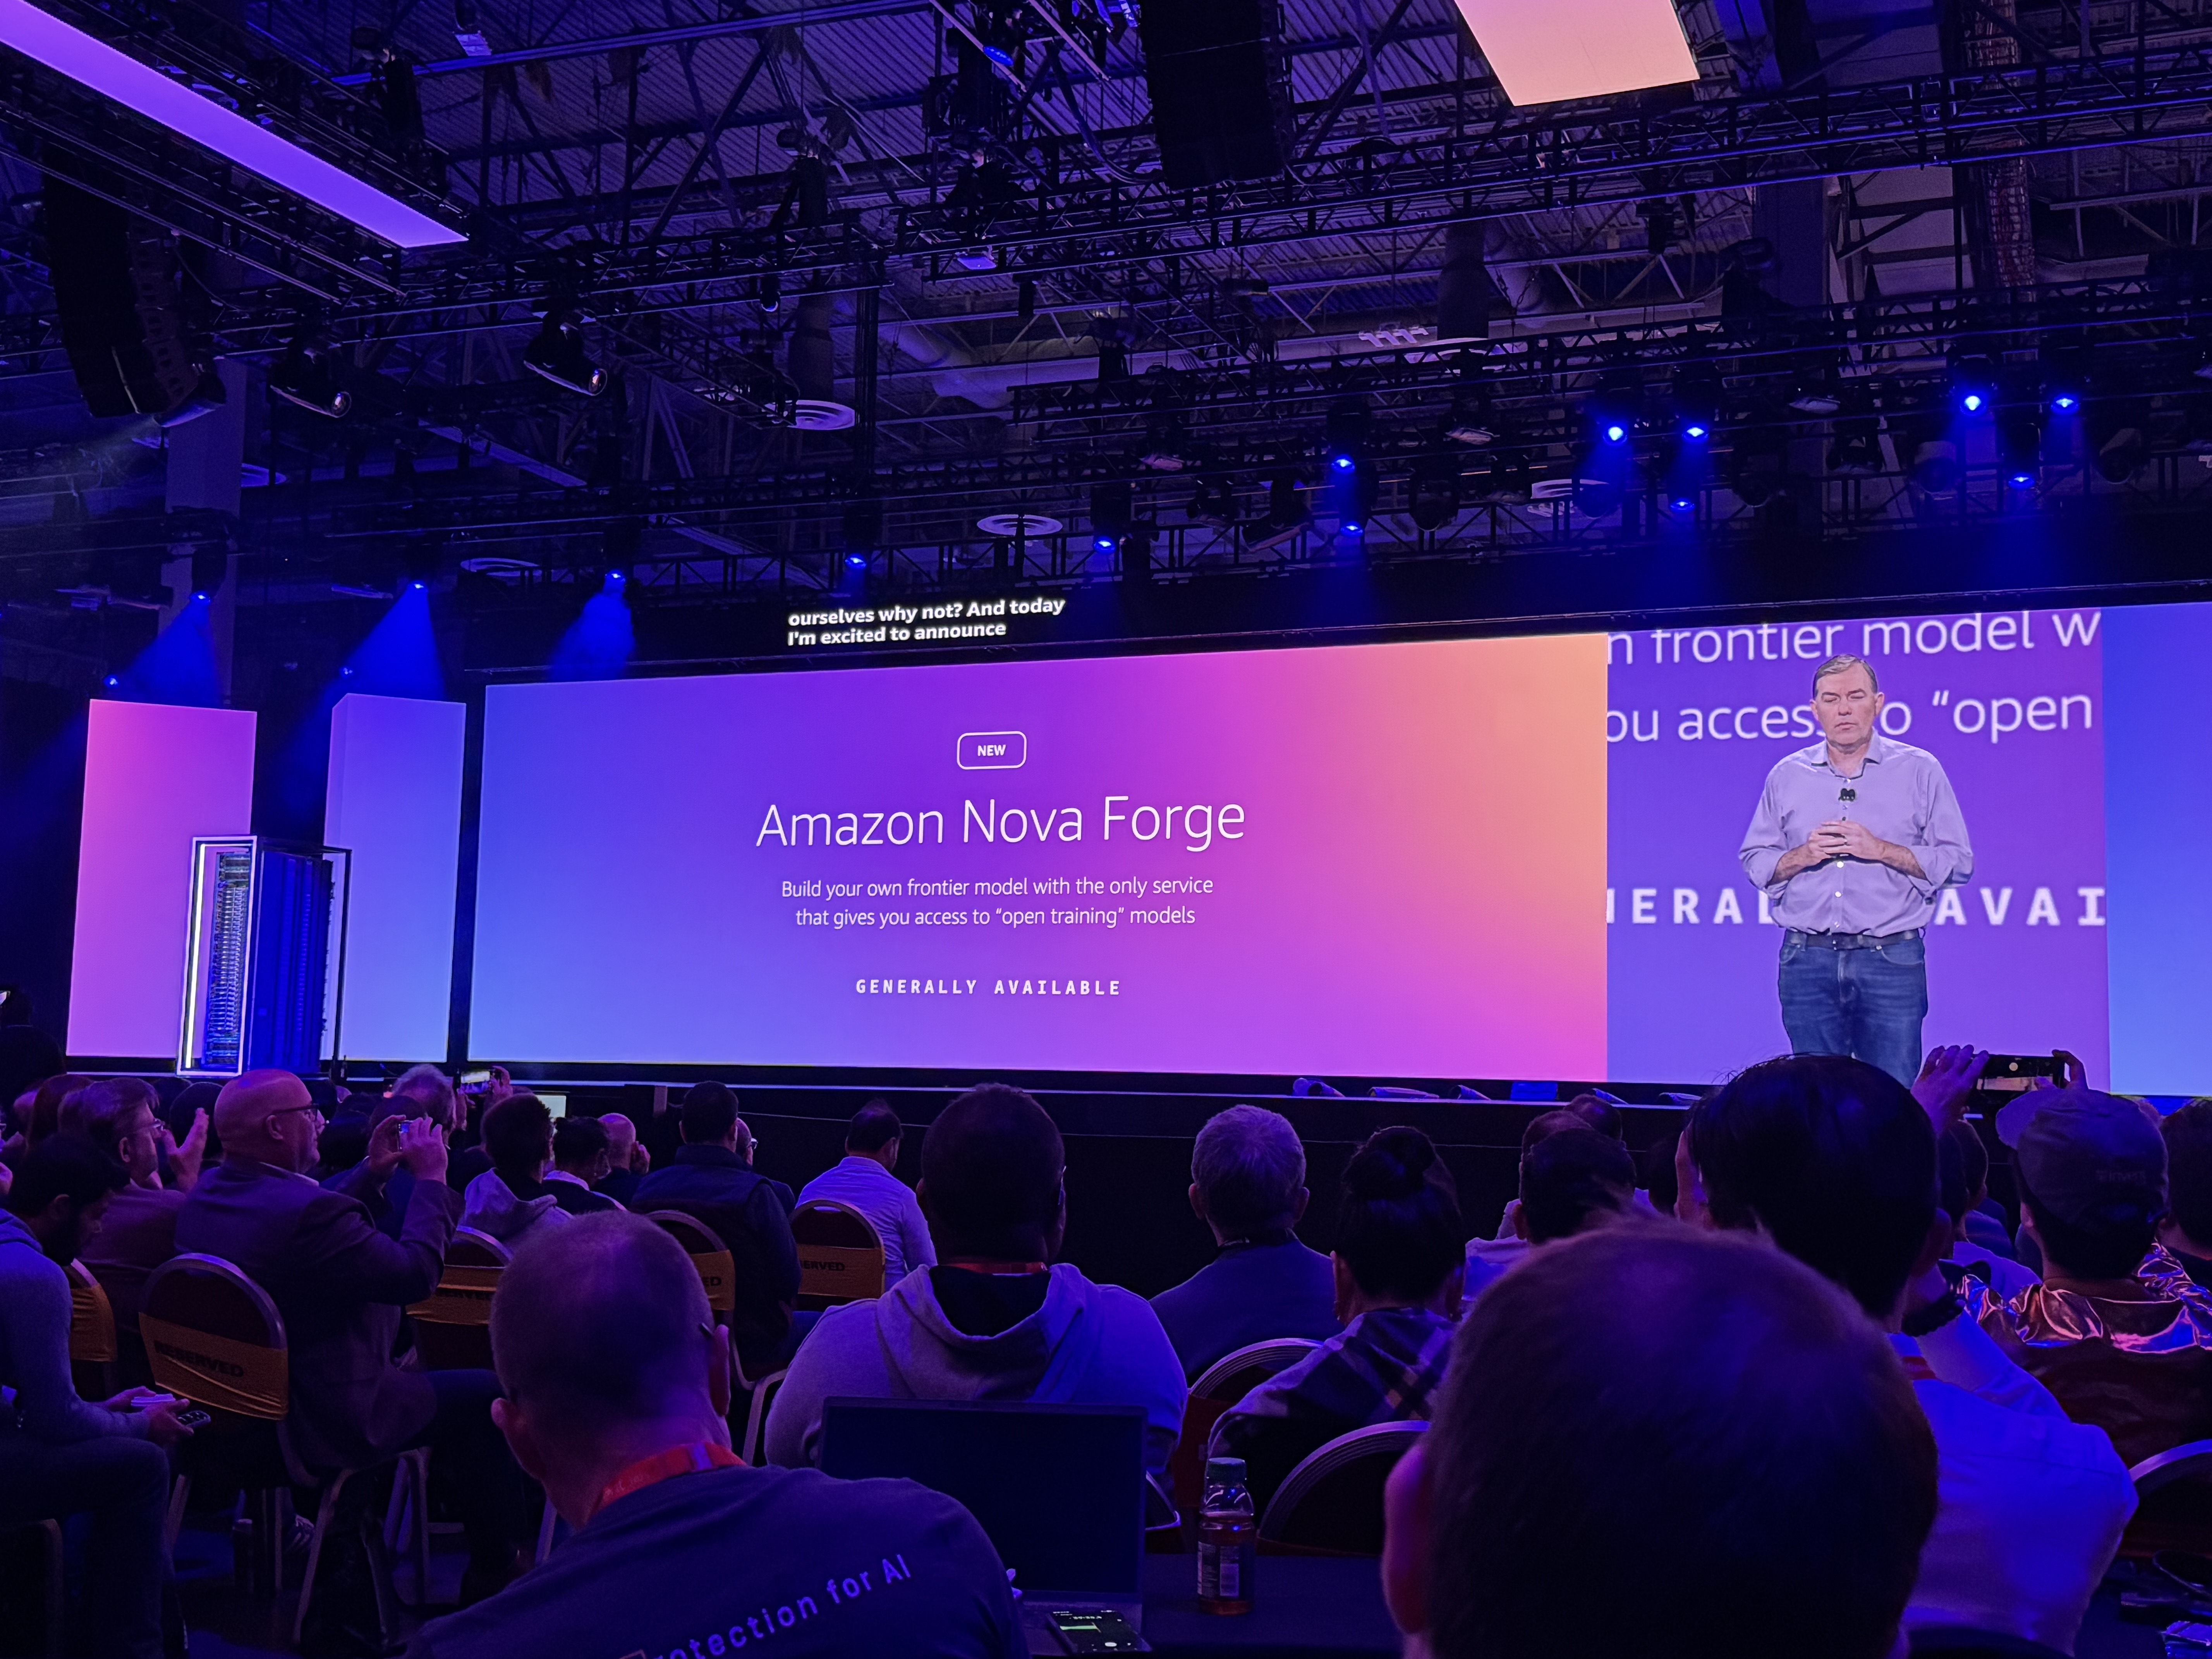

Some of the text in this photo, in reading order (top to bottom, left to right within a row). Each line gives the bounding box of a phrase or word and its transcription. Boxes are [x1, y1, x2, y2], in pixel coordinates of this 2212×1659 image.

[788, 598, 1066, 627] ourselves why not? And today
[788, 623, 1006, 646] I'm excited to announce
[1650, 623, 1844, 664] frontier
[1862, 611, 2035, 657] model
[1678, 705, 1826, 741] acces
[977, 744, 1006, 757] NEW
[756, 796, 1245, 852] Amazon Nova Forge
[782, 876, 1214, 901] Build your own frontier model with the only service
[796, 908, 829, 926] that
[833, 908, 875, 929] gives
[879, 912, 910, 929] you
[915, 912, 968, 925] access
[972, 908, 991, 925] to
[1130, 905, 1196, 924] models
[1934, 887, 2106, 926] AVAI
[856, 979, 1120, 995] GENERALLY AVAILABLE
[800, 1260, 845, 1271] ERVED
[826, 1571, 872, 1604] for
[881, 1554, 911, 1584] AI
